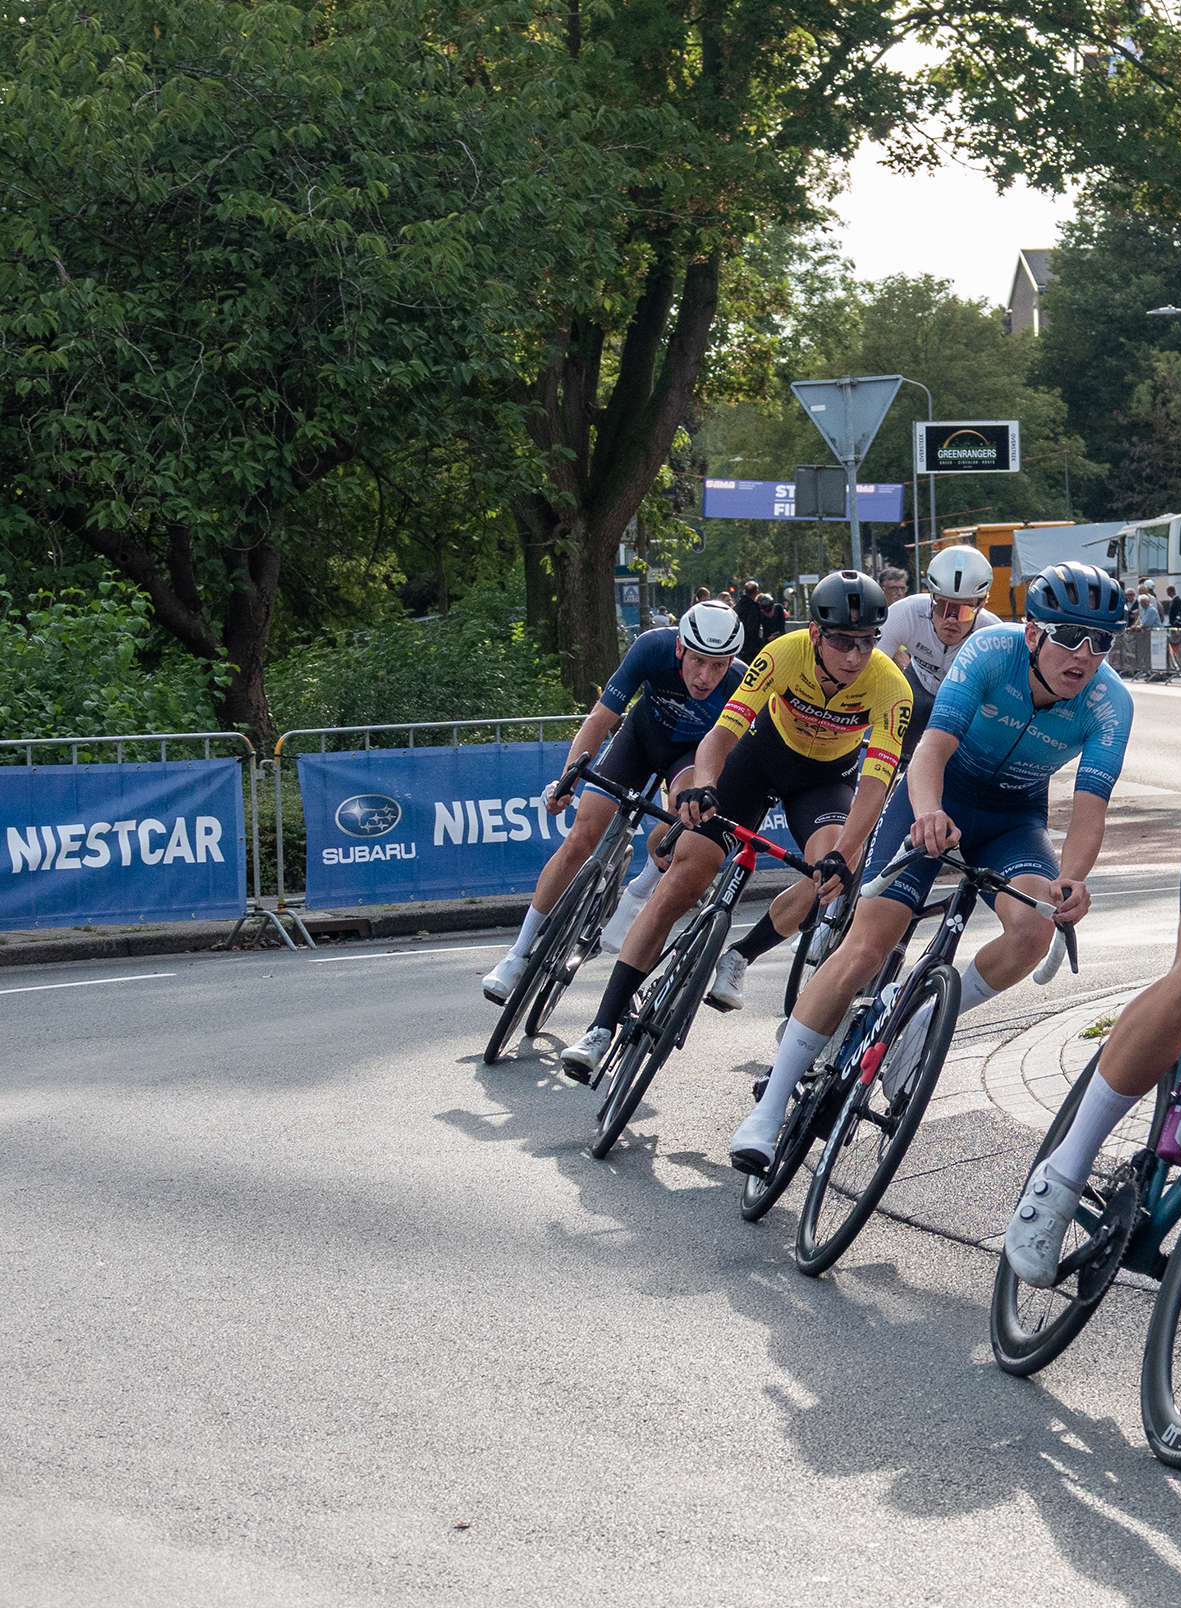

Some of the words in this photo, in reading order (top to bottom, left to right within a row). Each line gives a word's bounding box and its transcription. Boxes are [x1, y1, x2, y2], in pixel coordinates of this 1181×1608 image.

[938, 449, 997, 458] GREENRANGERS
[959, 643, 978, 669] AW
[975, 635, 1014, 654] Groep
[743, 657, 768, 688] RIS
[607, 684, 627, 701] TACTIC
[789, 697, 860, 726] Rabobank
[898, 706, 910, 737] RIS
[998, 714, 1025, 730] AW
[1026, 724, 1068, 751] Groep
[7, 815, 225, 874] NIESTCAR
[322, 843, 417, 865] SUBARU
[722, 866, 745, 905] BMC
